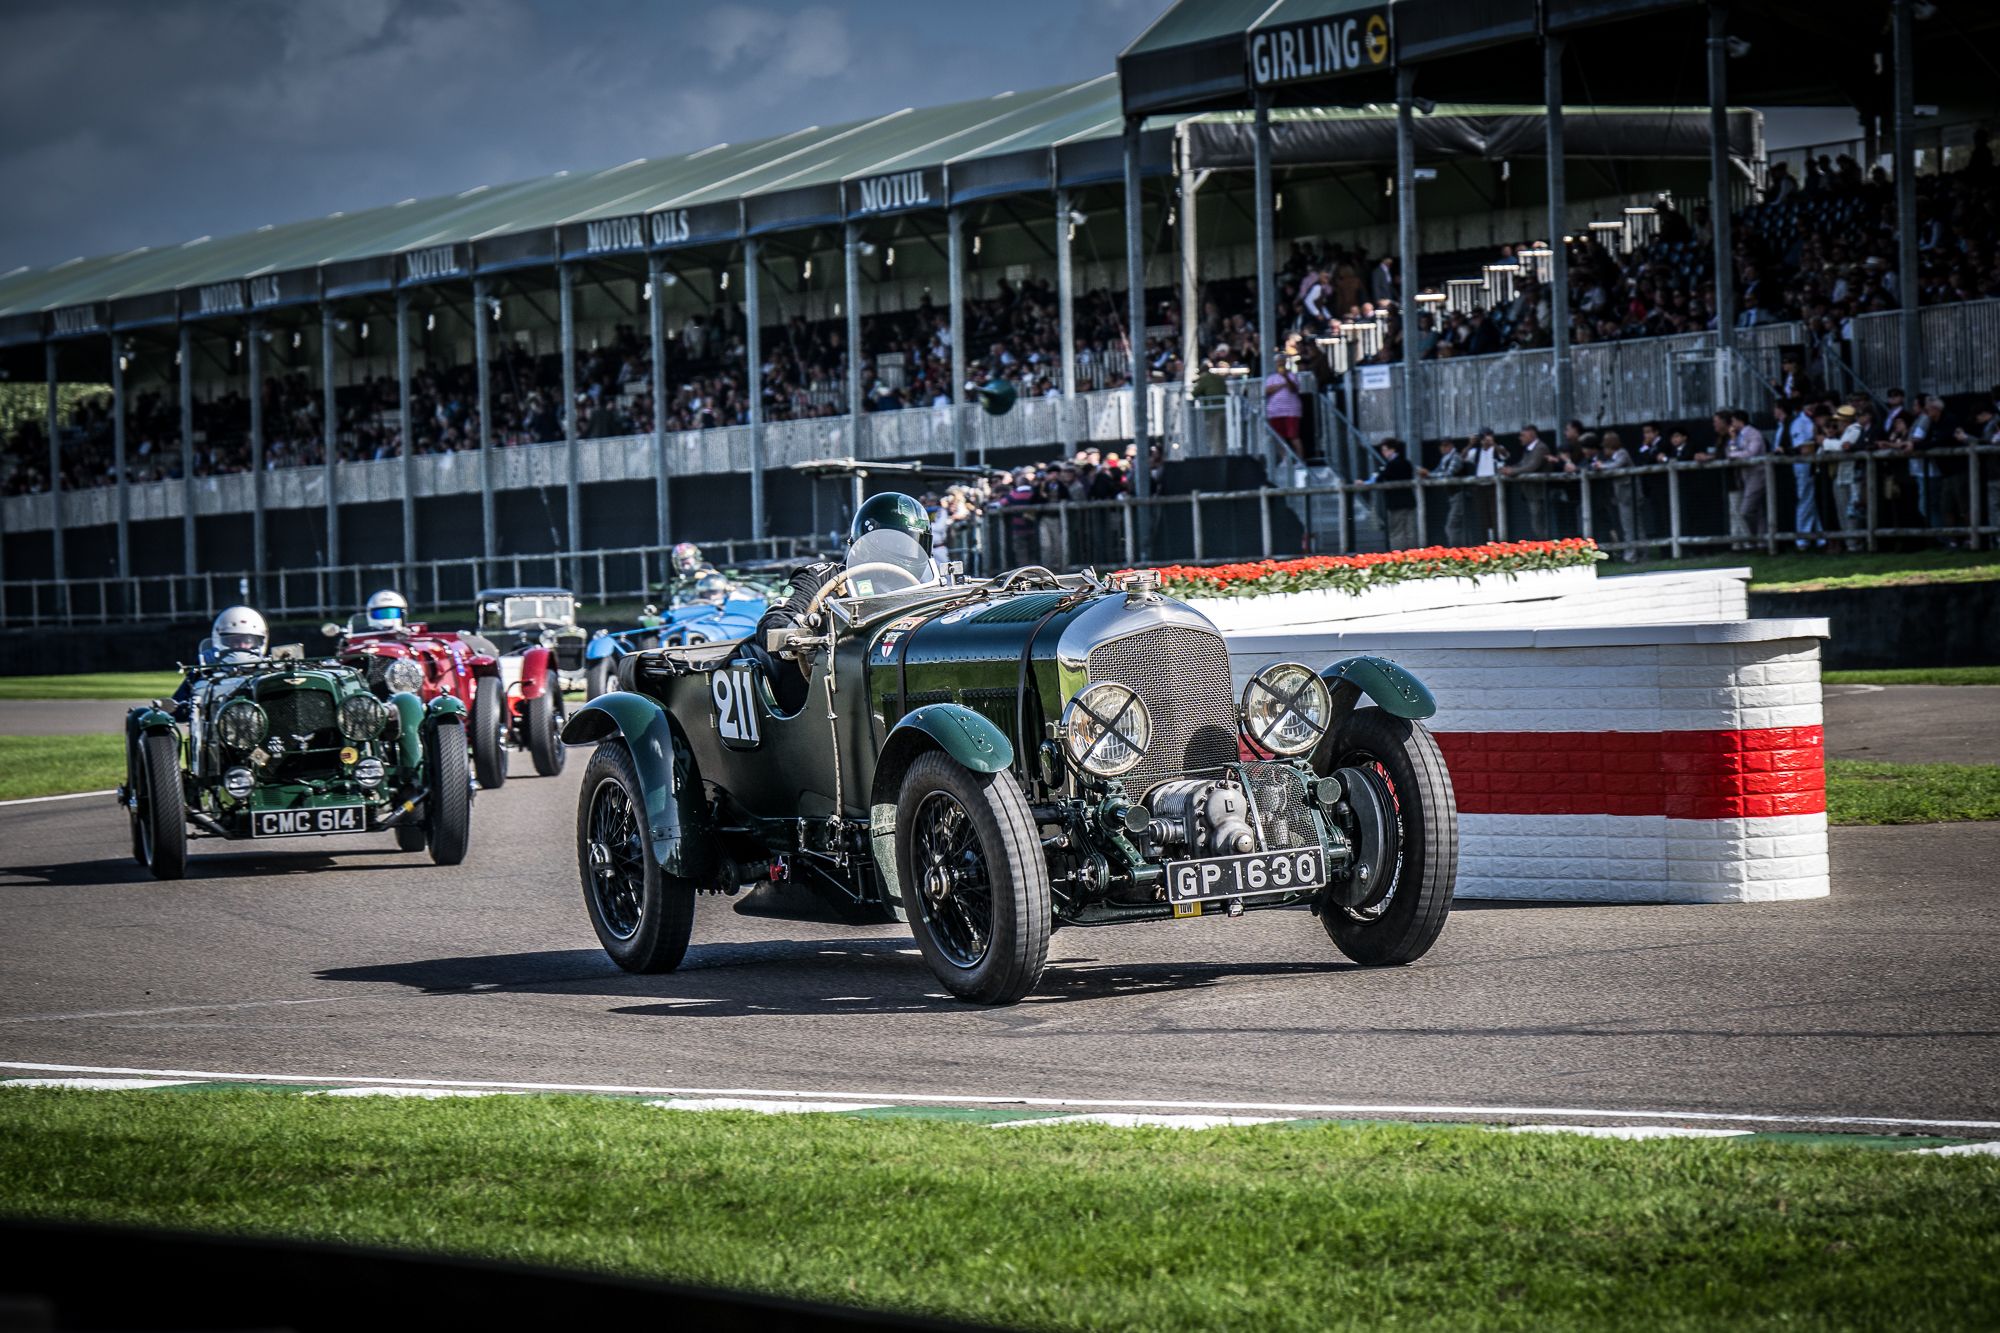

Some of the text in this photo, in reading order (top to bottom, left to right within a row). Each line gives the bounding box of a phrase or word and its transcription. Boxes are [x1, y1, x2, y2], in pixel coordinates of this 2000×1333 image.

[1253, 18, 1360, 84] GIRLING
[859, 170, 930, 213] MOTUL
[587, 210, 690, 253] MOTOR OILS
[405, 244, 459, 282] MOTUL
[712, 669, 760, 742] 211
[262, 808, 356, 834] CMC 614
[1177, 853, 1316, 896] GP 1630
